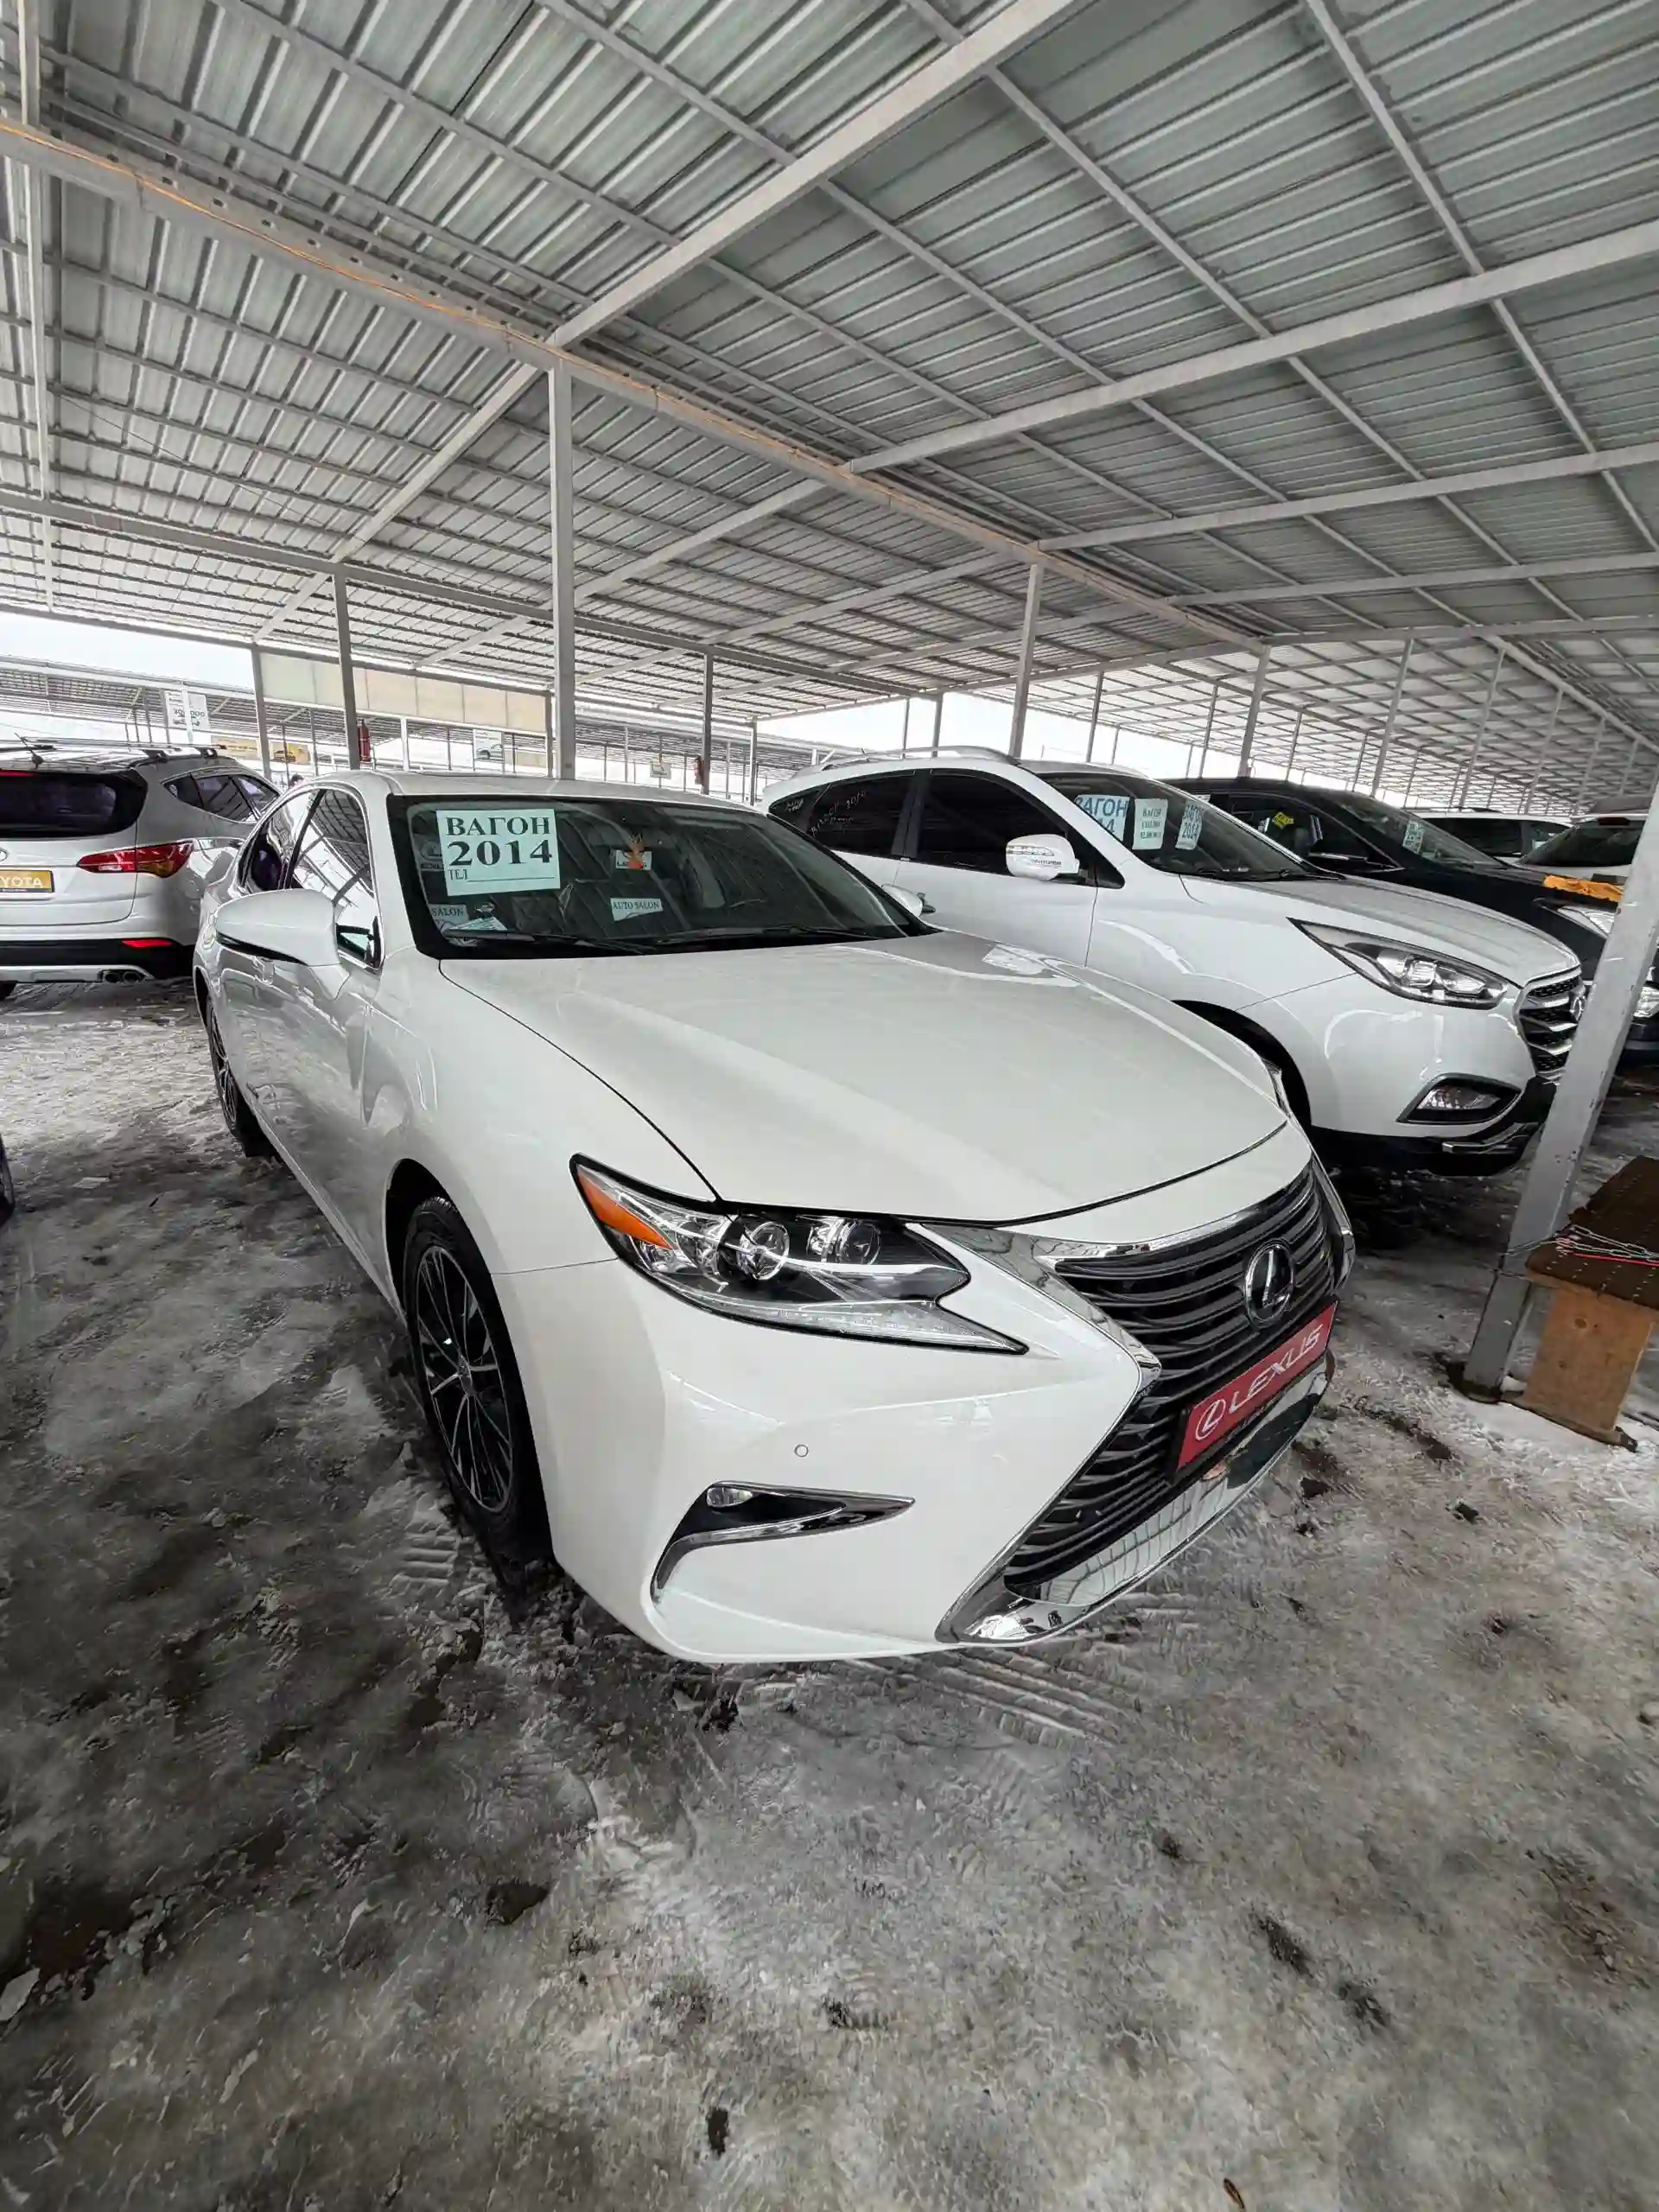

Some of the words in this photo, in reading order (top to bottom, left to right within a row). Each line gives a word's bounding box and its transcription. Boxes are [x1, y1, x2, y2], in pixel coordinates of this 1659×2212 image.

[444, 817, 550, 836] ВАГОН
[447, 839, 553, 866] 2014
[1229, 1324, 1324, 1414] LEXUS
